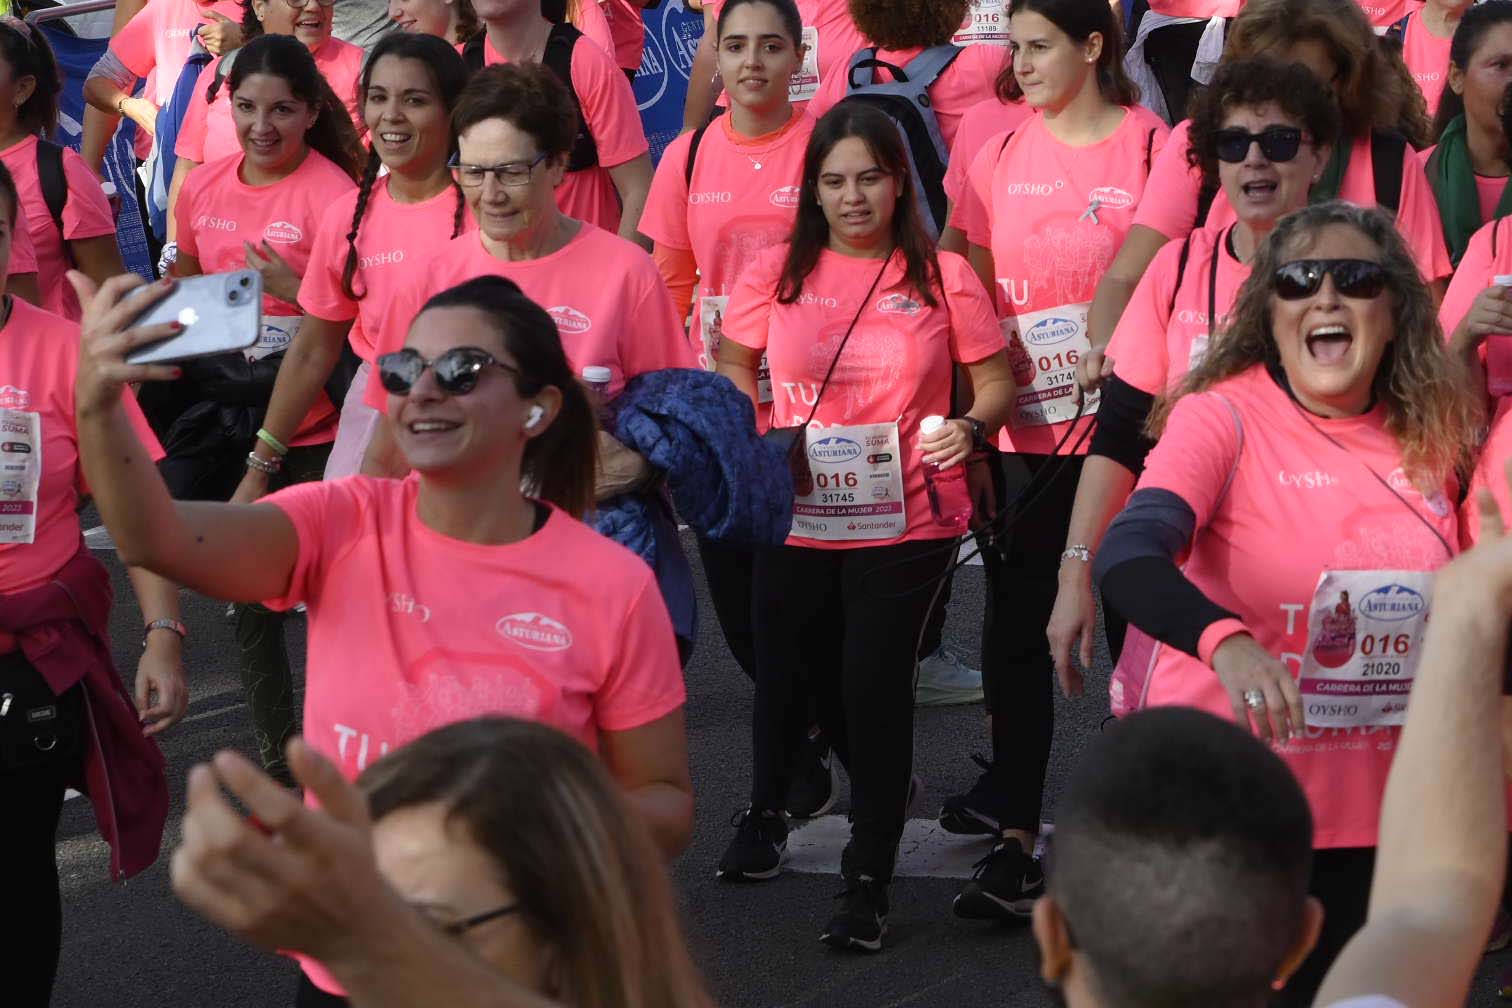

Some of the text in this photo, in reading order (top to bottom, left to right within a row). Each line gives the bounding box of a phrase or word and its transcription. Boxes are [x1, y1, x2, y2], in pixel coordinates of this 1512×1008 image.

[690, 190, 732, 205] OYSHO
[1031, 326, 1076, 343] ASTURIANA
[1038, 349, 1080, 372] 016
[781, 381, 819, 407] TU
[810, 446, 858, 458] ASTURIANA
[816, 471, 858, 488] 016
[821, 492, 855, 504] 31745
[826, 507, 836, 515] DE
[837, 506, 846, 515] LA
[857, 521, 896, 530] Santander
[1364, 599, 1420, 613] ASTURIANA
[499, 621, 572, 648] ASTURIANA
[1360, 633, 1410, 656] 016
[1361, 662, 1401, 677] 21020
[1316, 683, 1361, 692] CARRERA
[1363, 683, 1375, 692] DE
[1375, 683, 1387, 692] LA
[1308, 703, 1358, 716] OYSHO
